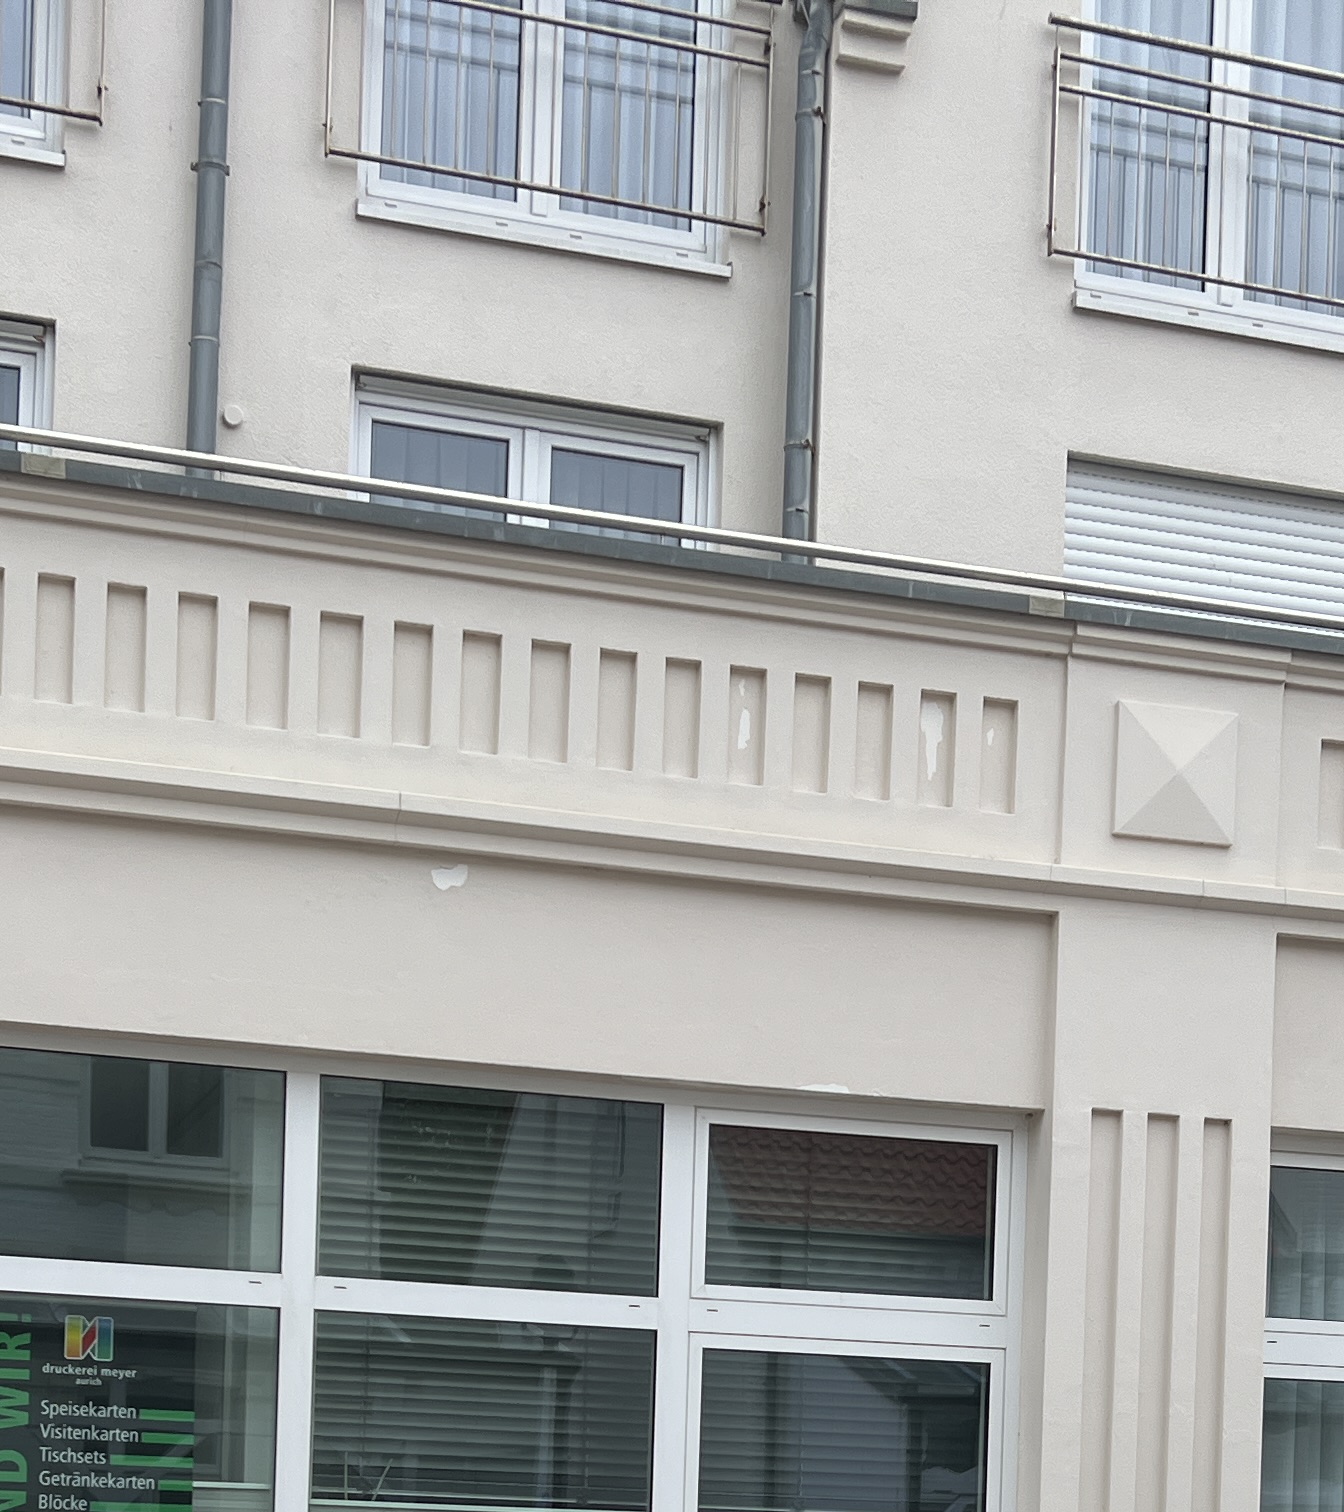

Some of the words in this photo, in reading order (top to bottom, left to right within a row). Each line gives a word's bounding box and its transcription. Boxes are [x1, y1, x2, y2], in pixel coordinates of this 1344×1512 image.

[42, 1363, 97, 1376] druckerei
[100, 1367, 137, 1380] meyer
[75, 1377, 102, 1386] aurich
[40, 1400, 137, 1419] Speisekarten
[39, 1423, 139, 1442] Visitenkarten
[39, 1446, 106, 1464] Tischsets
[38, 1470, 155, 1490] Getränkekarten
[38, 1493, 88, 1511] Blöcke
